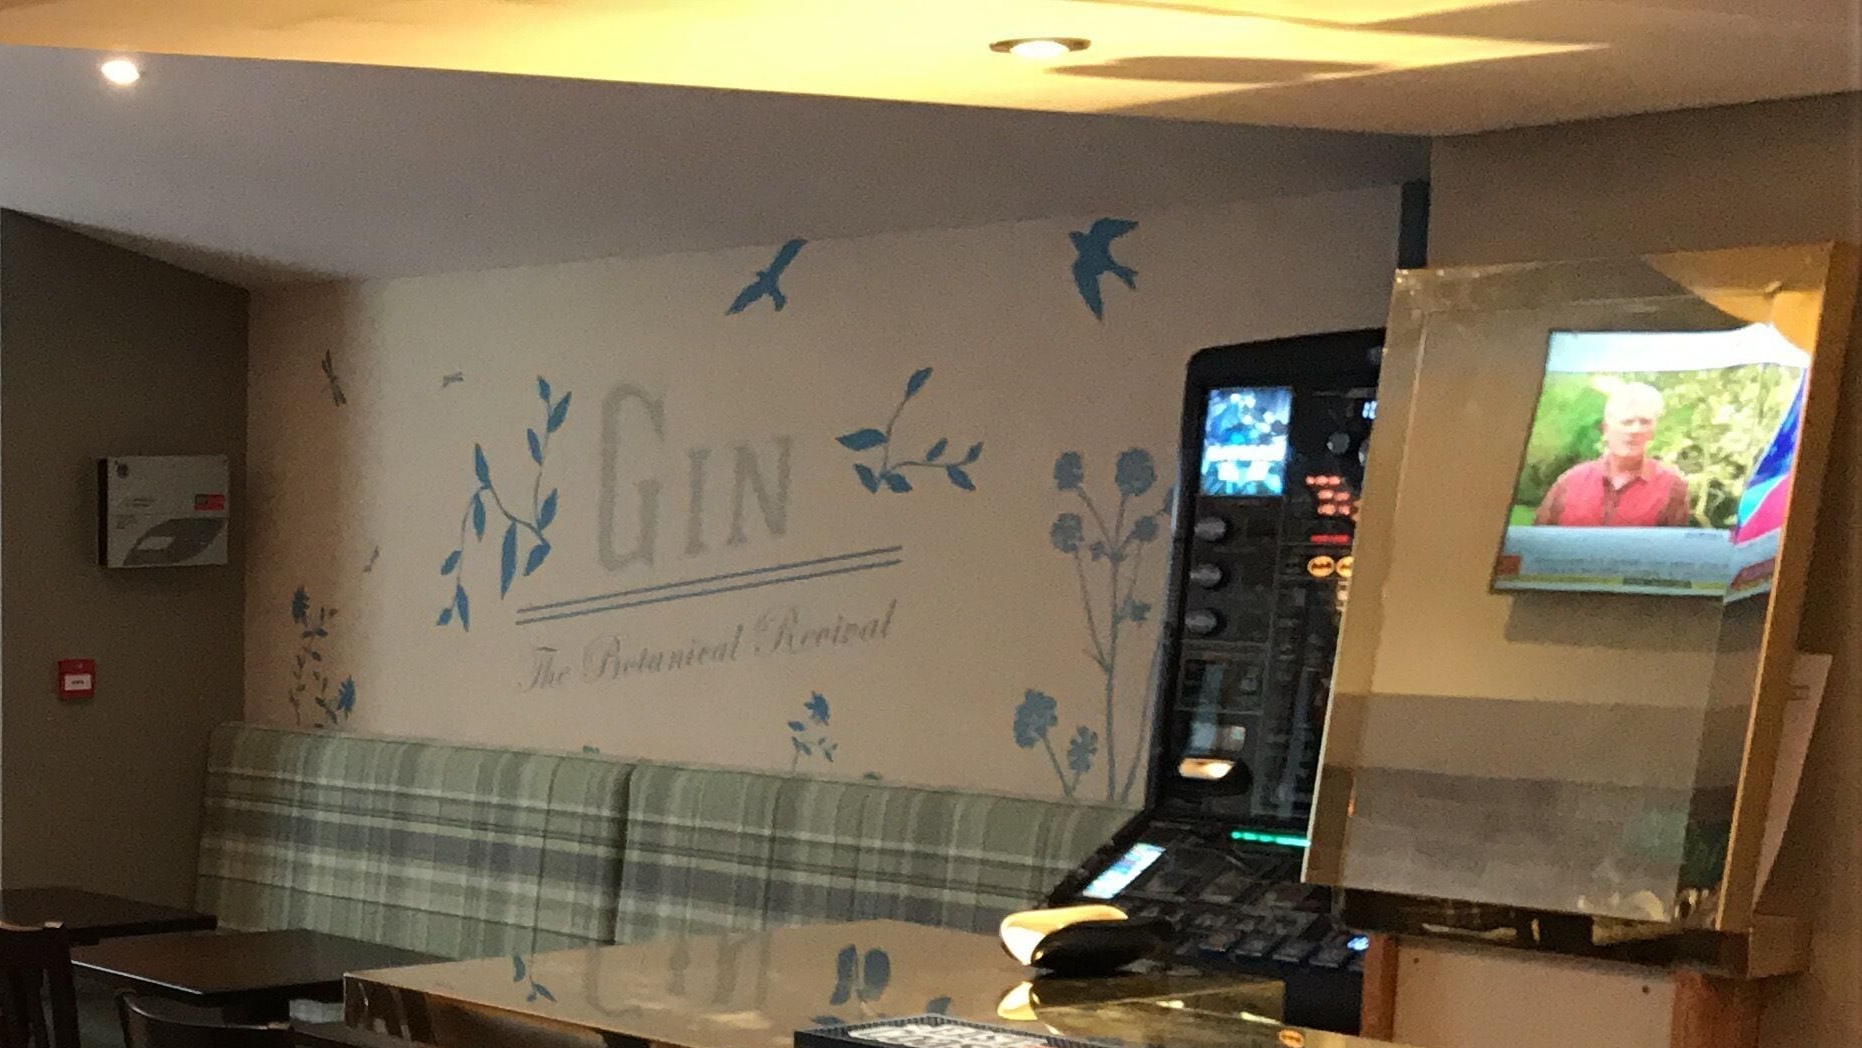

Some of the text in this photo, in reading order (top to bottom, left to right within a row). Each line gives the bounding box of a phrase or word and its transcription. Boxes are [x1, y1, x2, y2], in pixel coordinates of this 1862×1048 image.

[597, 381, 794, 573] GIN
[517, 599, 898, 692] The Botanical Revival
